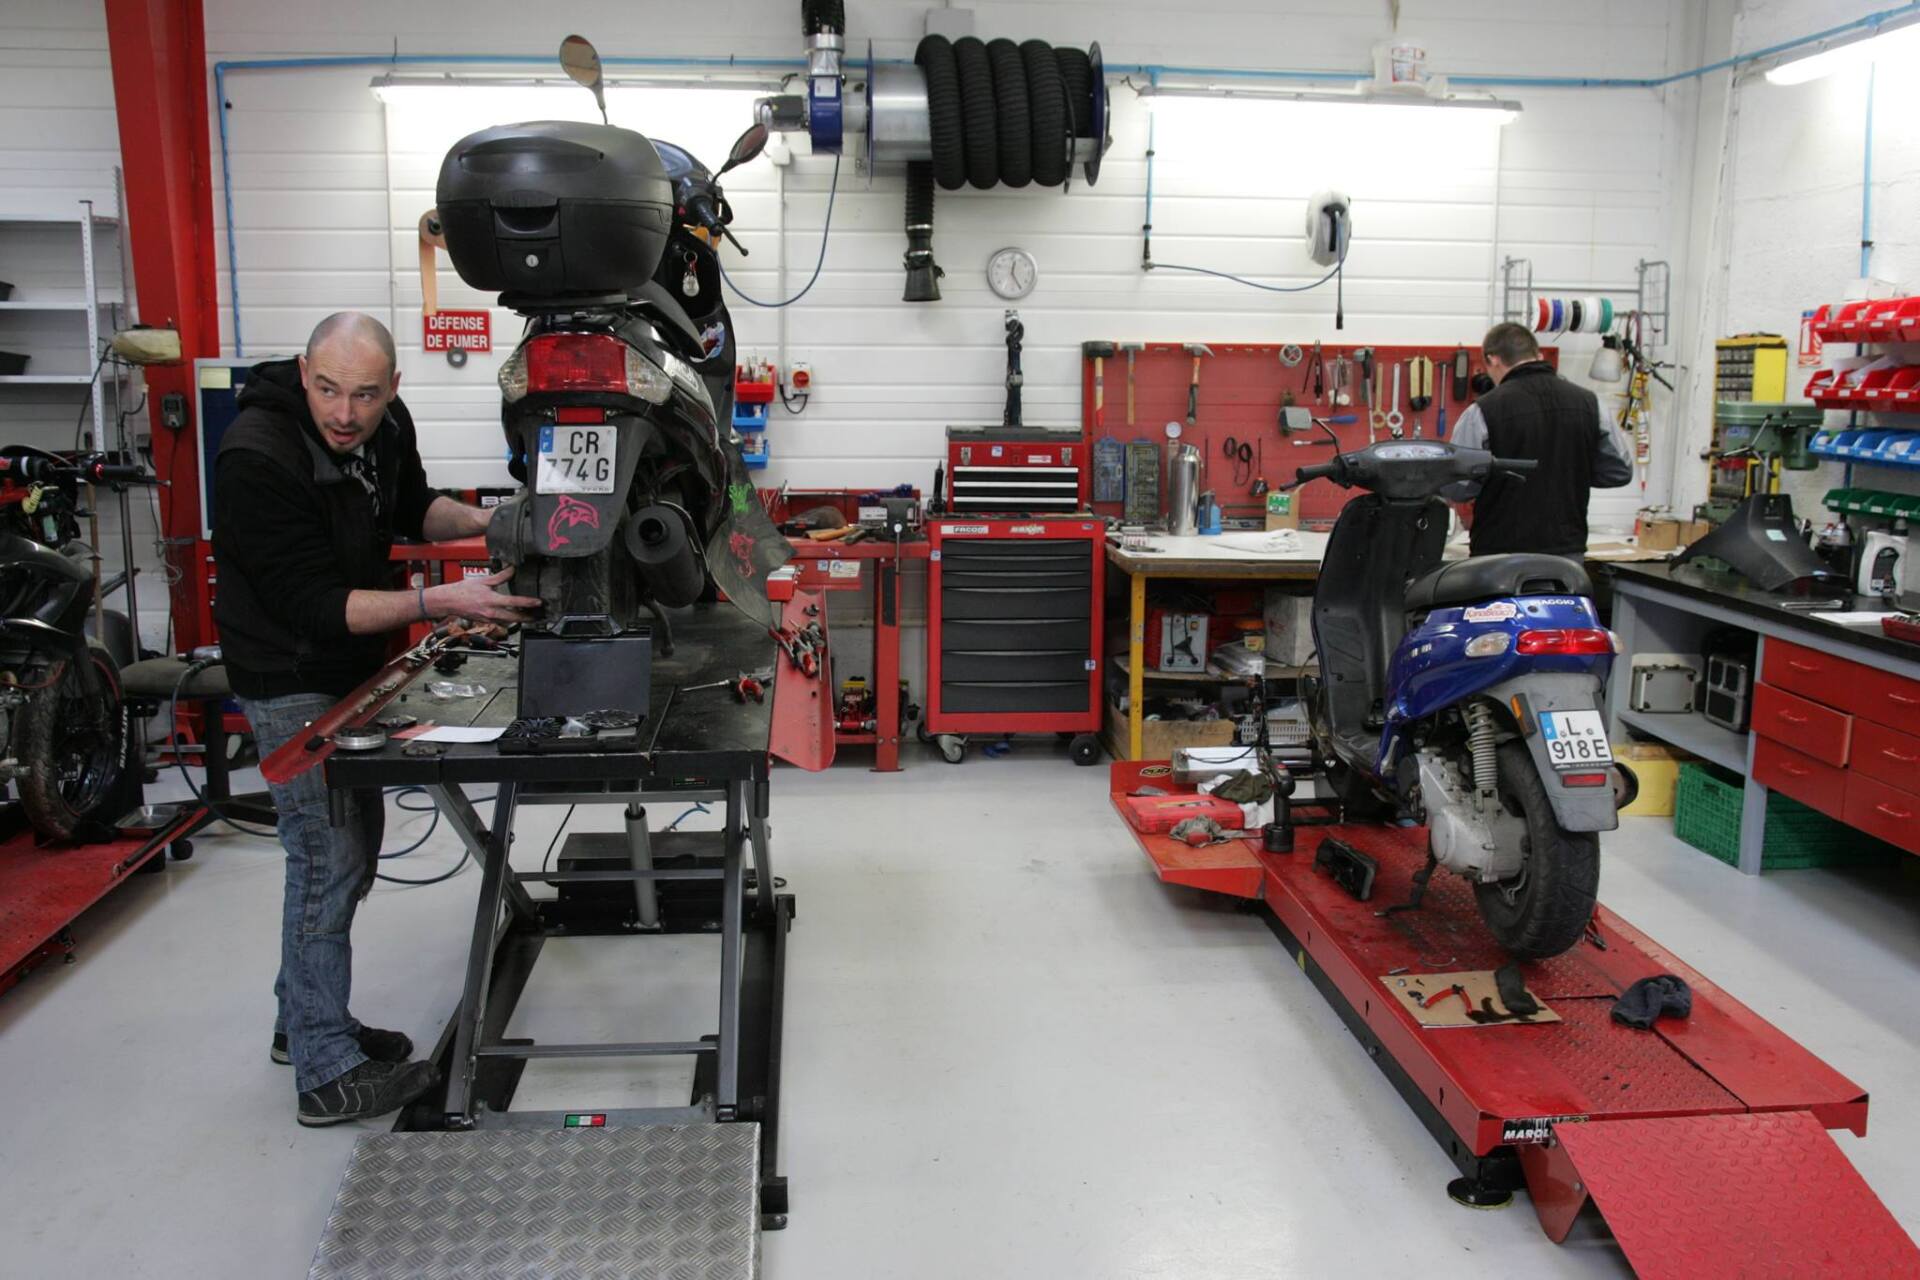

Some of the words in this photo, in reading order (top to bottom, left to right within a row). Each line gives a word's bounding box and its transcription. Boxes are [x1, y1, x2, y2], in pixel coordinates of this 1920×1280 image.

[429, 313, 485, 331] DÉFENSE
[426, 334, 443, 348] DE
[446, 335, 488, 348] FUMER
[570, 431, 599, 455] CR
[1565, 717, 1581, 735] L
[1552, 739, 1608, 760] 918E
